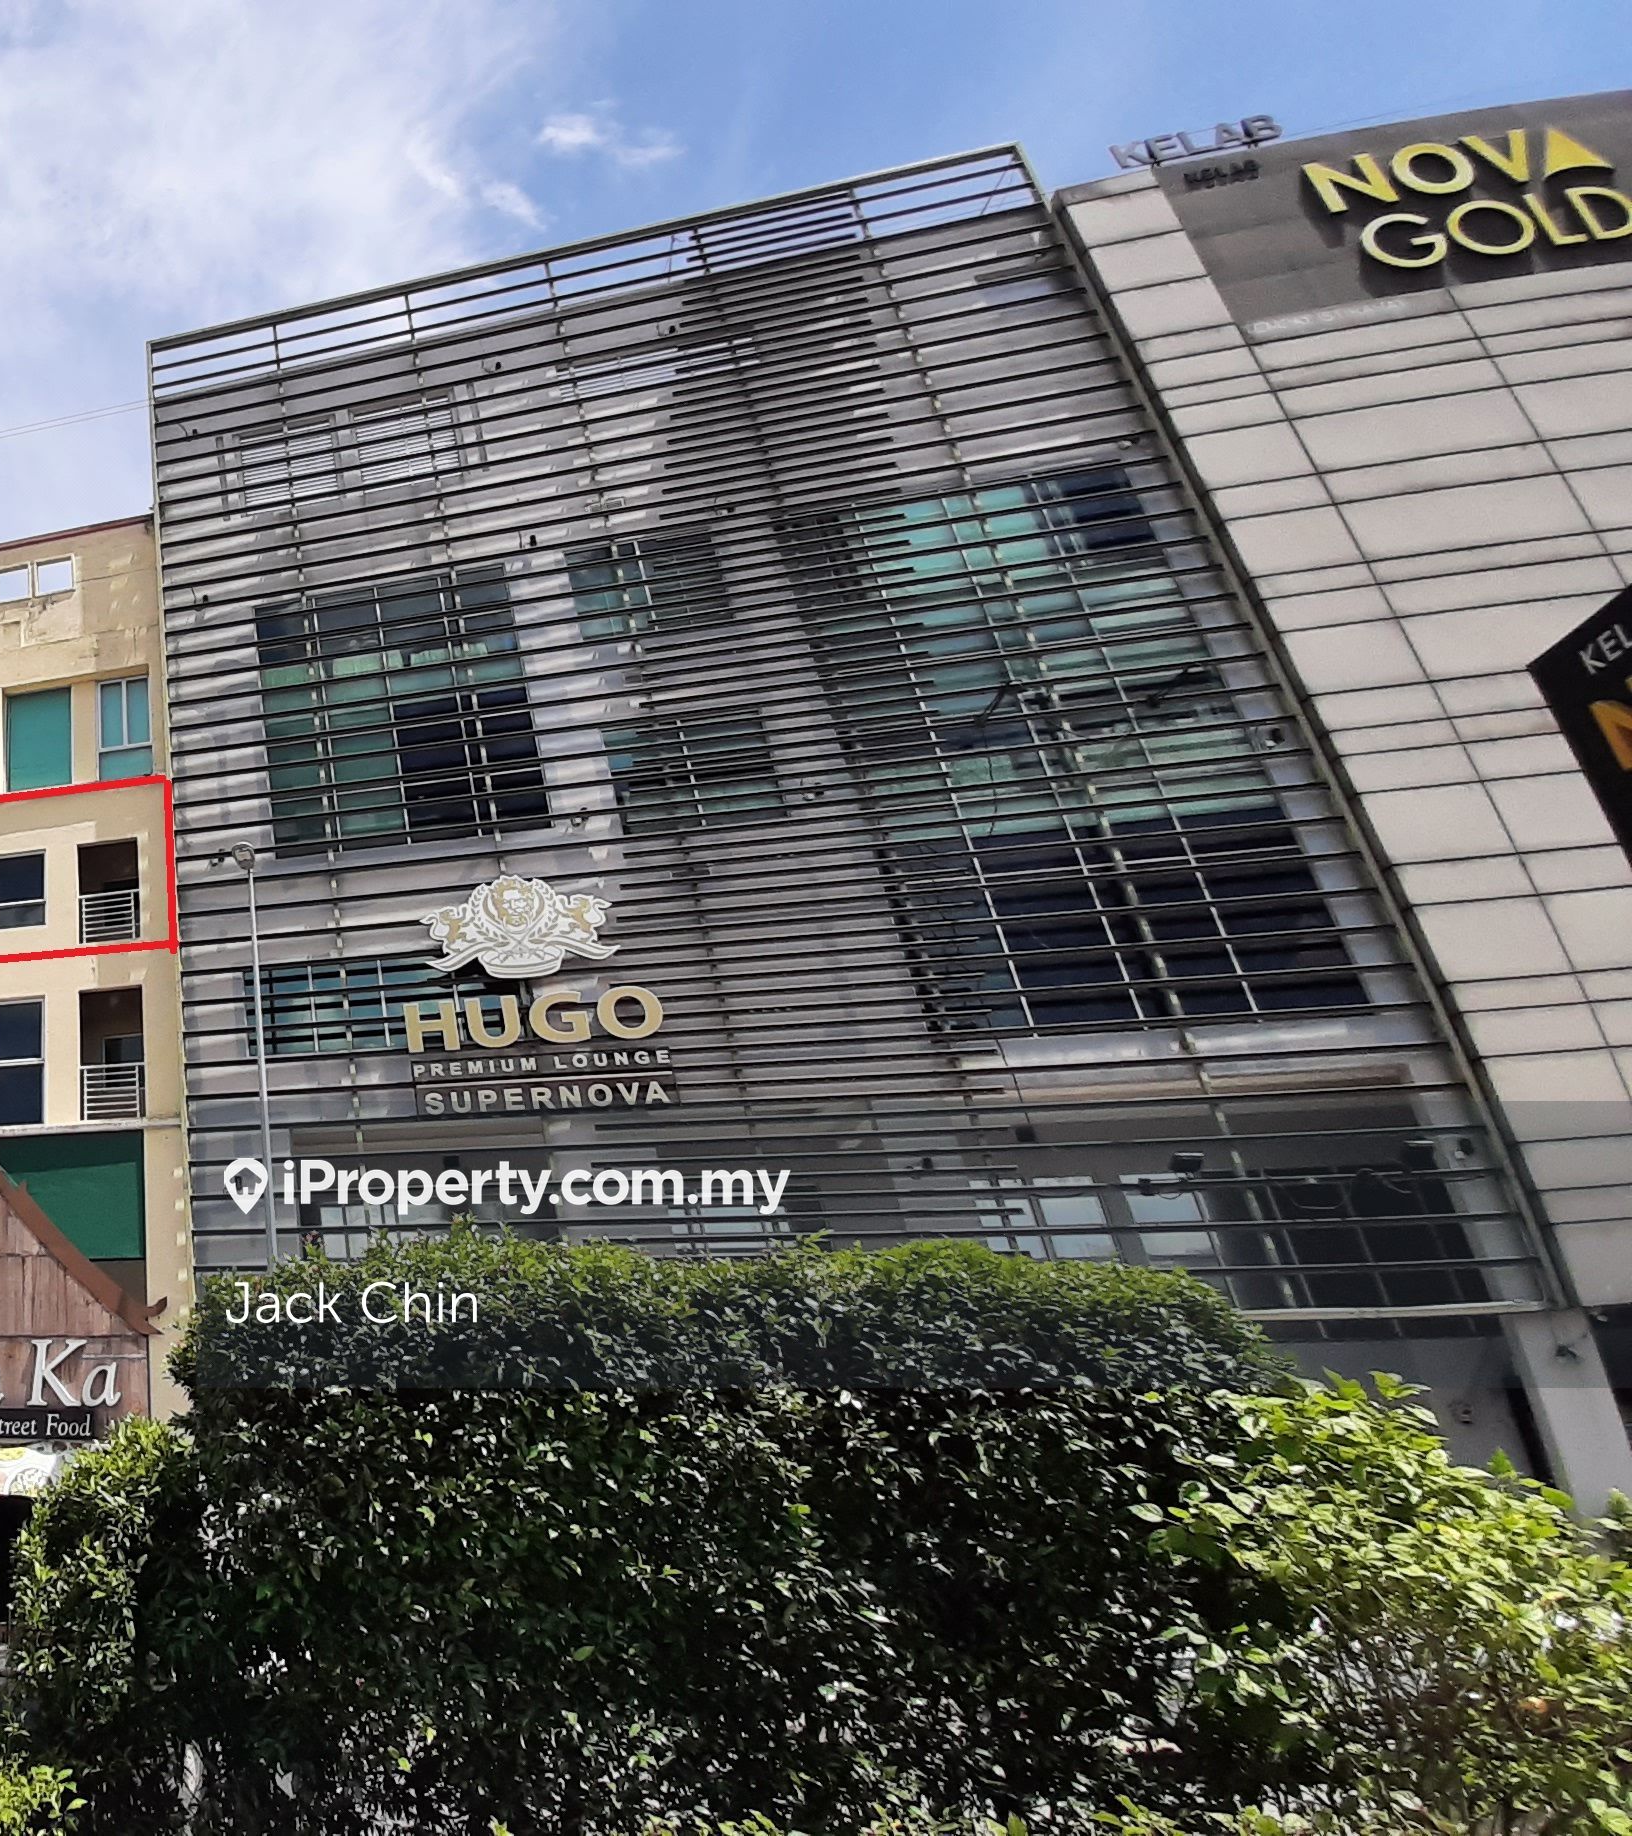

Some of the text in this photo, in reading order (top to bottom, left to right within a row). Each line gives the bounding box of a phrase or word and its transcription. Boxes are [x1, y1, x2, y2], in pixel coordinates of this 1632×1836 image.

[1109, 115, 1282, 169] KELAB
[1300, 126, 1614, 214] NOVA
[1360, 186, 1632, 268] GOLD
[403, 985, 664, 1053] HUGO
[413, 1049, 671, 1078] PREMIUM LOUNGE
[425, 1080, 669, 1115] SUPERNOVA
[26, 1339, 122, 1407] Ka
[45, 1412, 92, 1438] Food
